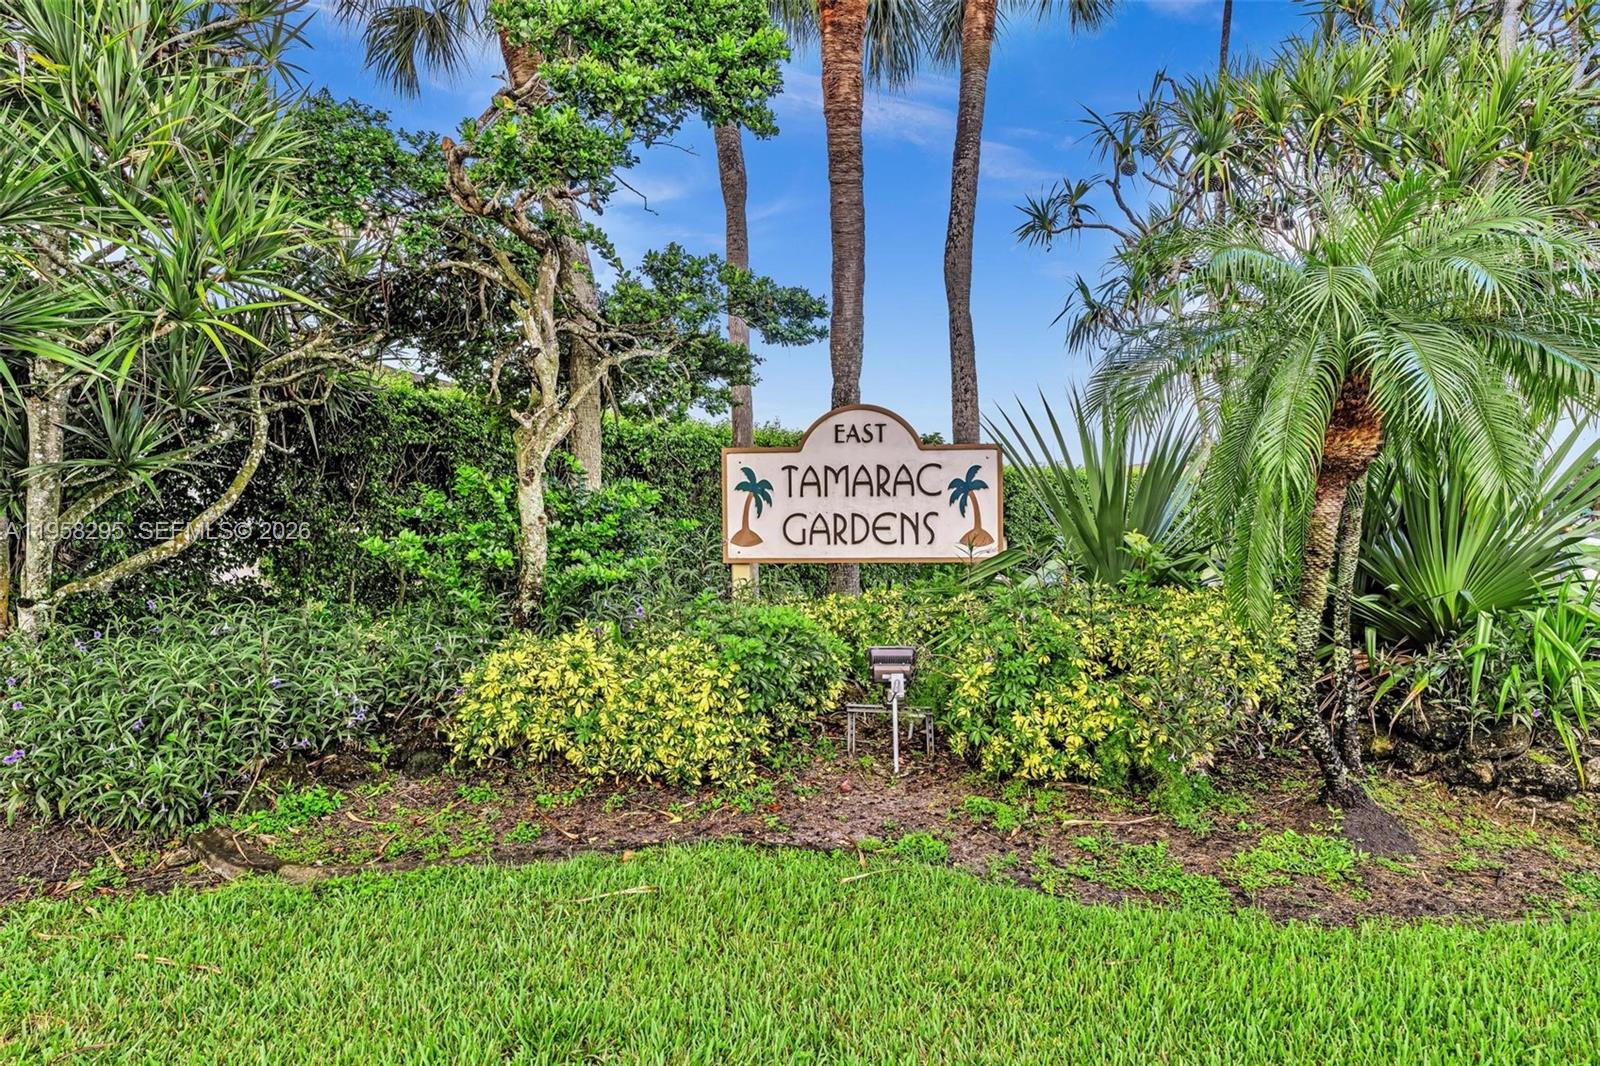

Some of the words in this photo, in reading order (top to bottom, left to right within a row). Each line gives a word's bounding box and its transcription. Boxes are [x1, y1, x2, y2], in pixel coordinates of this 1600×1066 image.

[835, 423, 887, 444] EAST
[781, 463, 943, 498] TAMARAC
[782, 511, 939, 546] GARDENS
